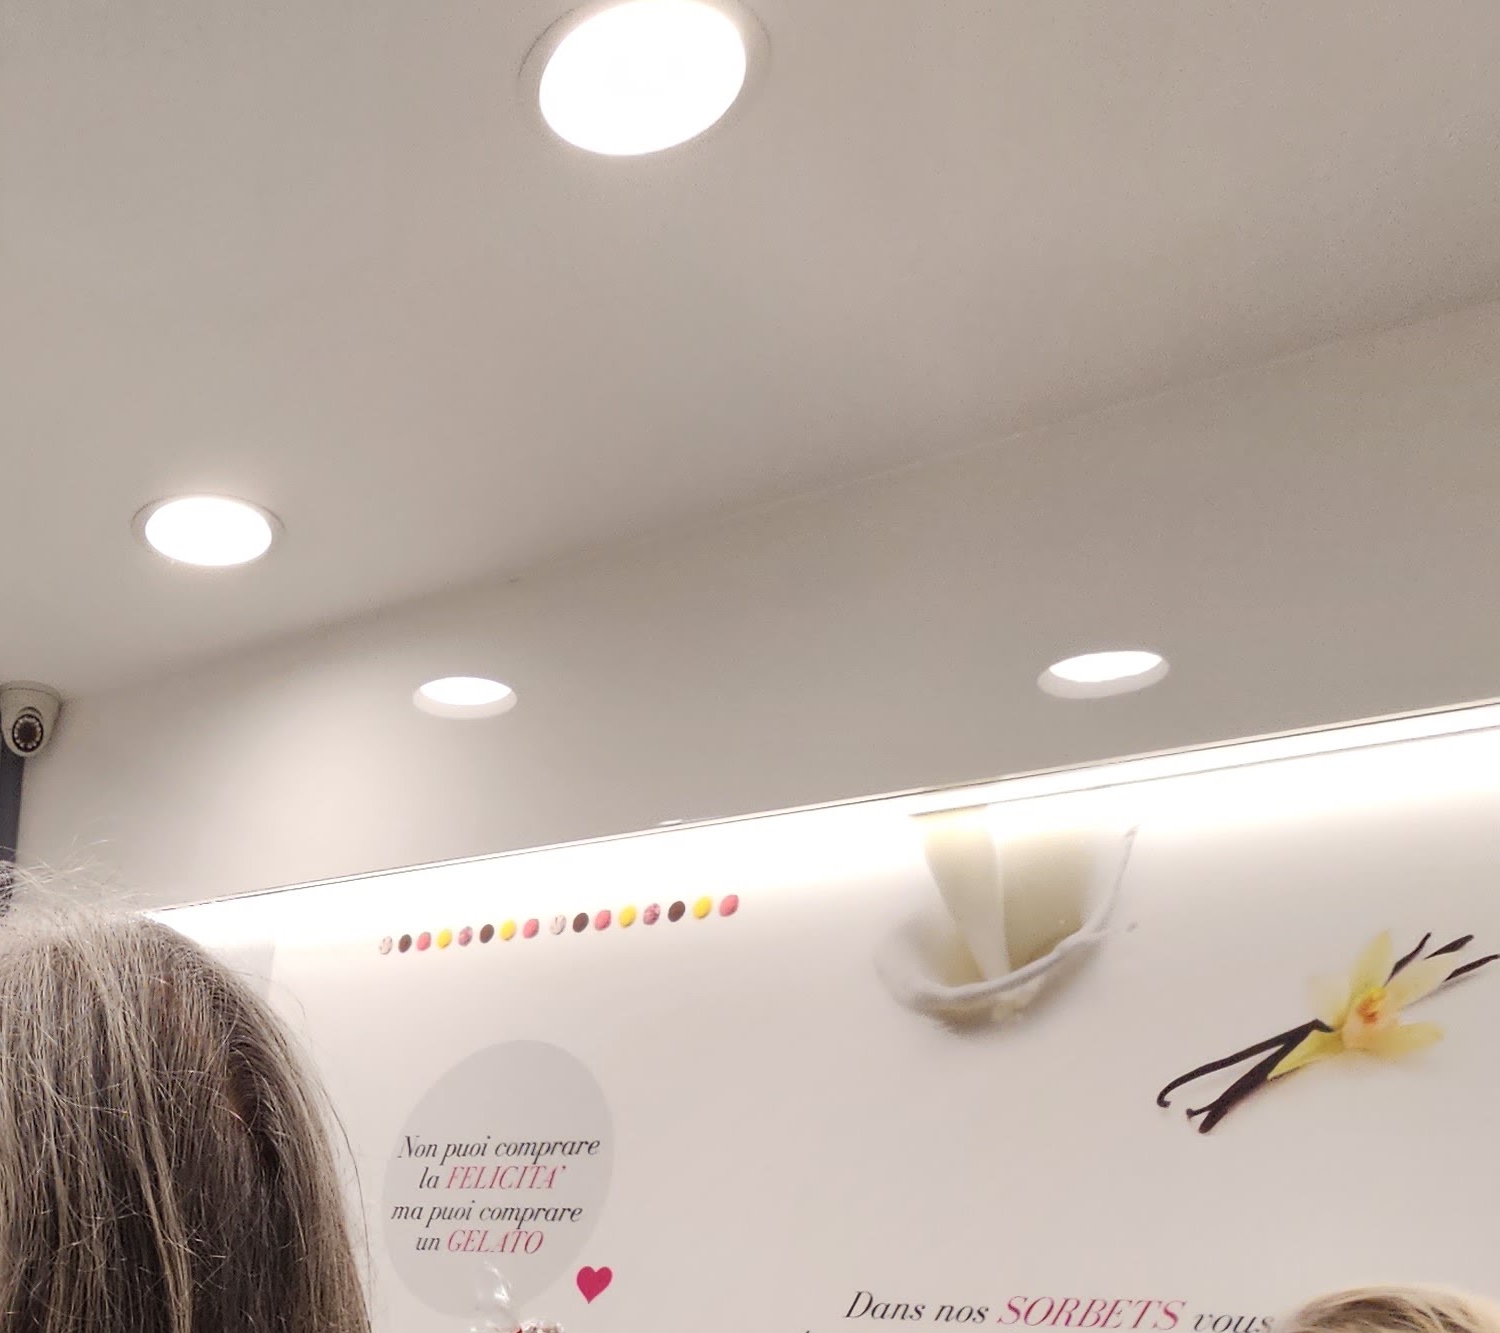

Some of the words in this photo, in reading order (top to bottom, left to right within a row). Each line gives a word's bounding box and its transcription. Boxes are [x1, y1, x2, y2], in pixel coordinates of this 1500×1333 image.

[397, 1135, 438, 1159] Non
[440, 1135, 491, 1165] puoi
[494, 1137, 600, 1165] comprare
[419, 1166, 440, 1190] la
[391, 1204, 423, 1220] ma
[426, 1199, 476, 1230] puoi
[479, 1204, 583, 1230] comprare
[415, 1234, 441, 1252] un
[447, 1229, 544, 1254] GELATO
[844, 1291, 926, 1322] Dans
[934, 1303, 989, 1324] nos
[997, 1295, 1187, 1330] SORBETS
